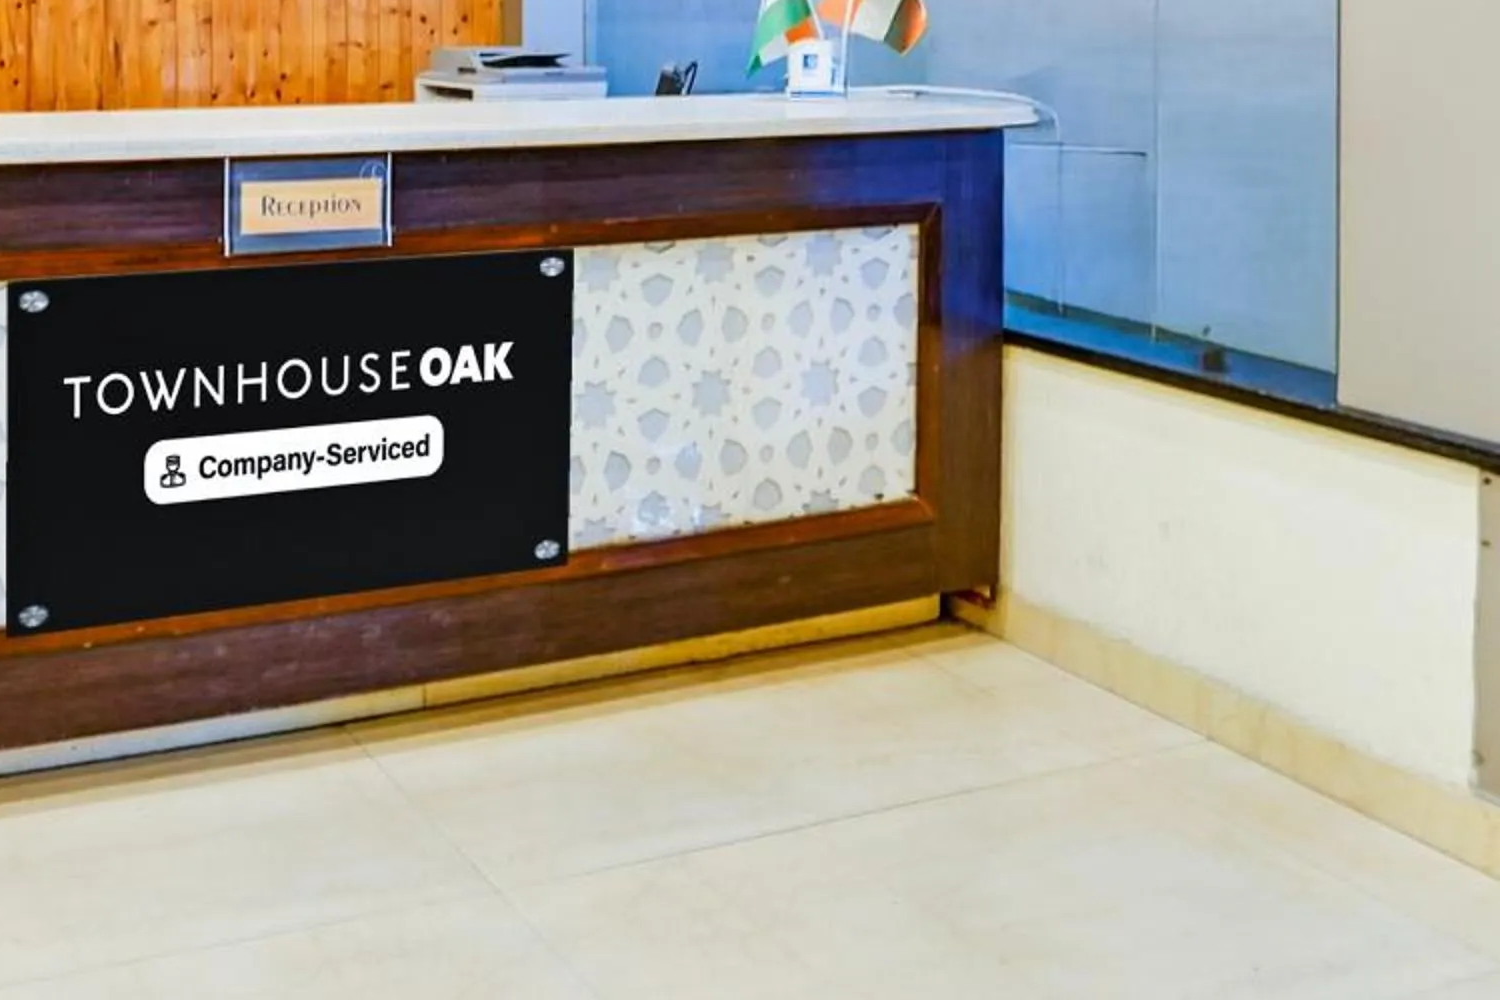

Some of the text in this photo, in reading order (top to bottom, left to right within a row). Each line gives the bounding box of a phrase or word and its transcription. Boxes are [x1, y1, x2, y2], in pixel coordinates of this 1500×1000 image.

[63, 341, 514, 419] TOWNHOUSE OAK
[198, 433, 430, 480] Company-Serviced
